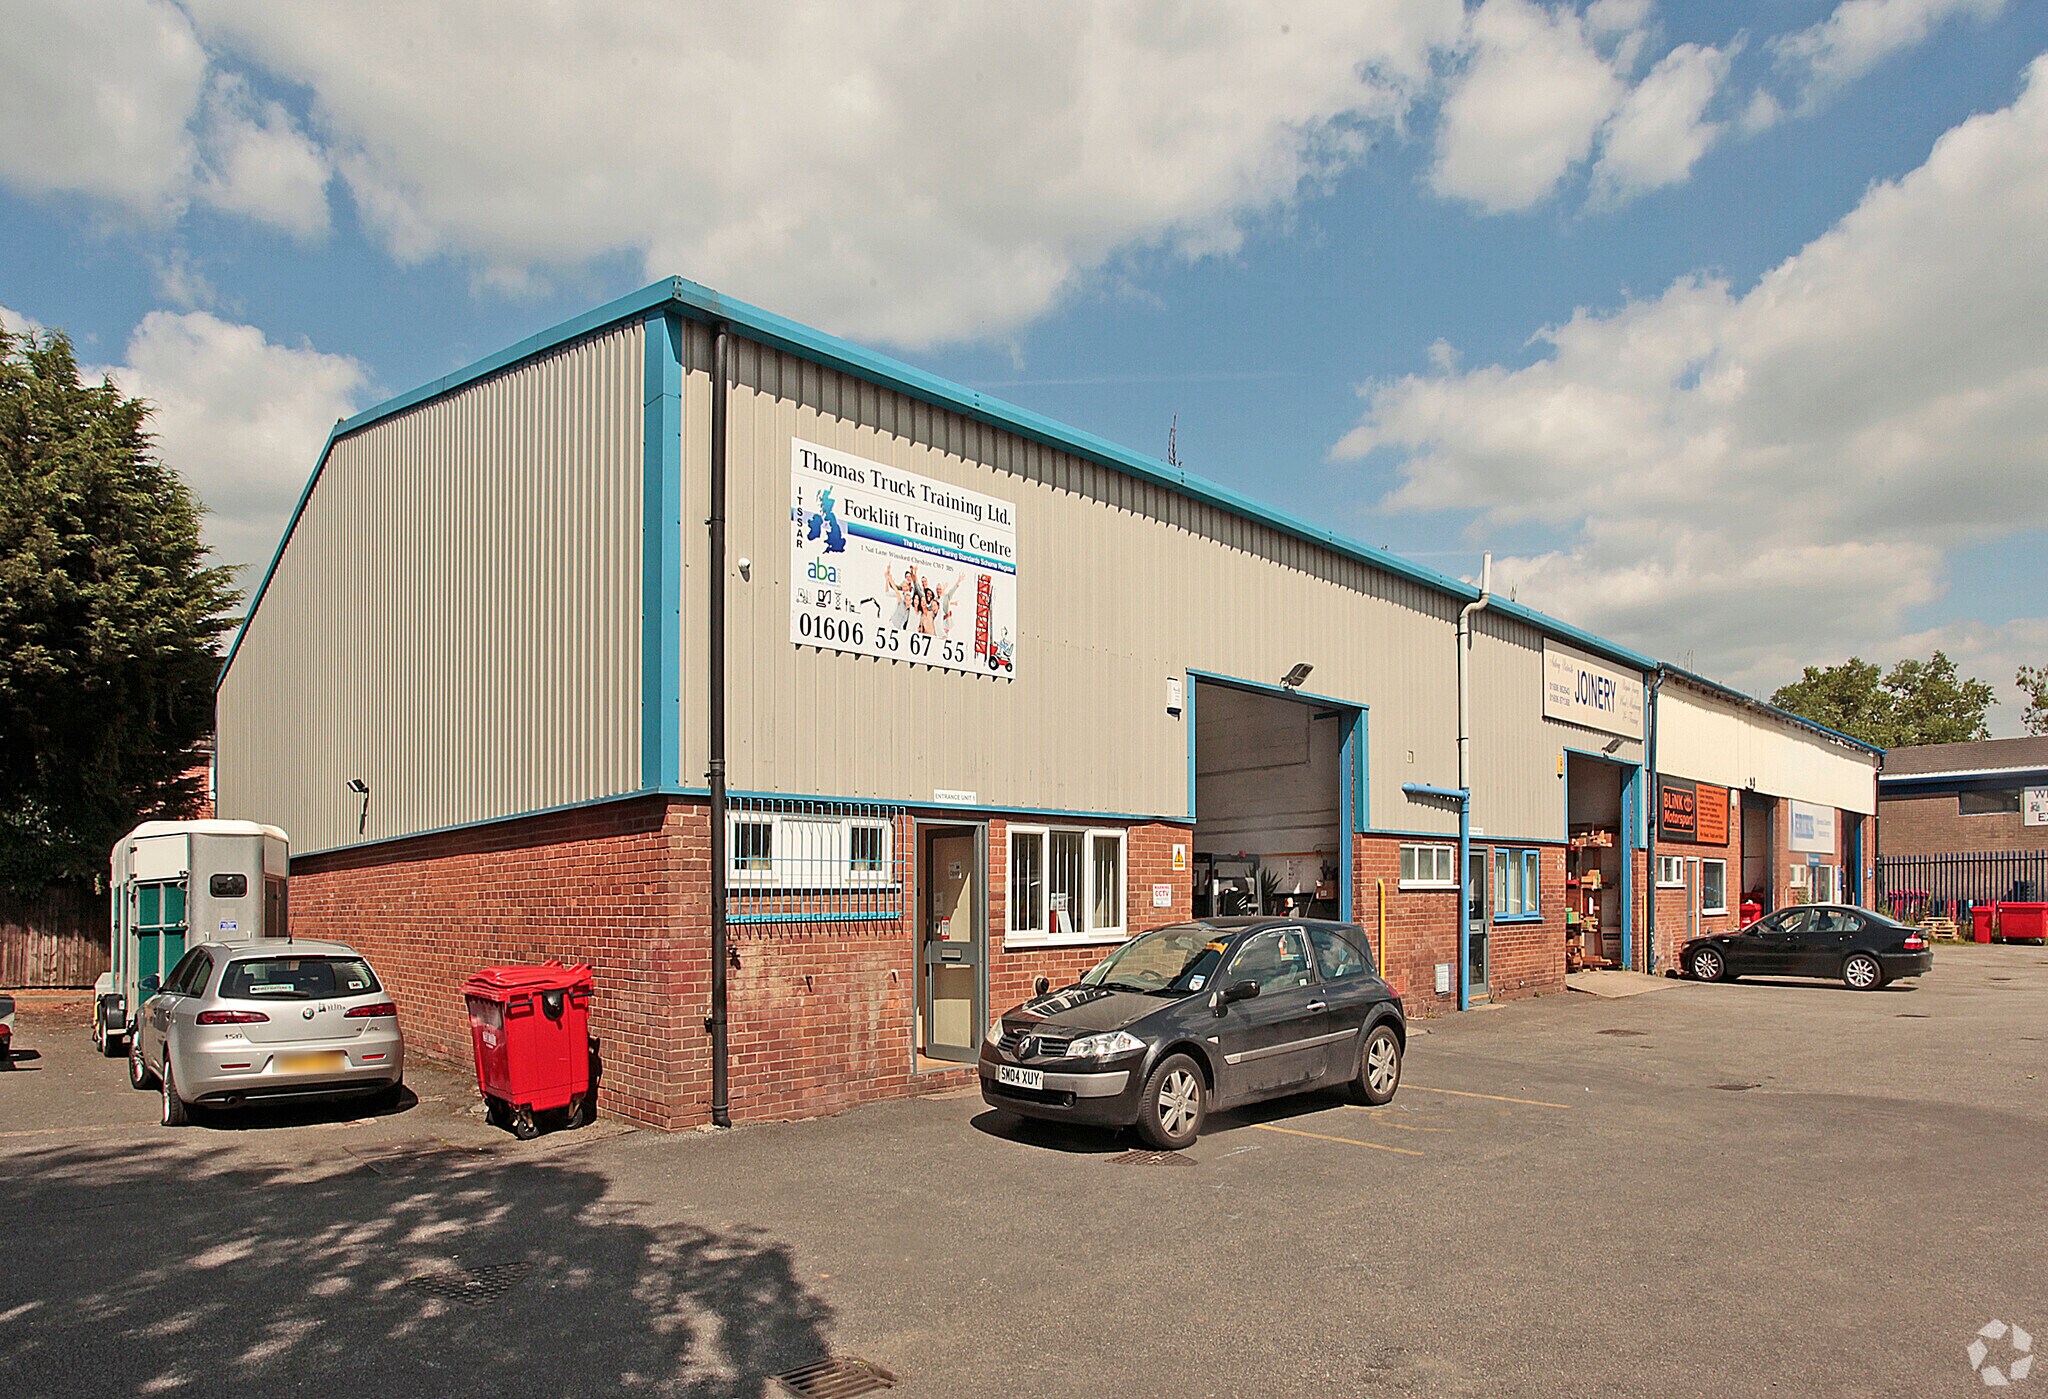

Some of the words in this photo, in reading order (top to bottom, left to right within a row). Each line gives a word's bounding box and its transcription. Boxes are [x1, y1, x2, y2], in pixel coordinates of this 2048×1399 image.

[800, 449, 865, 484] Thomas
[870, 469, 916, 498] Truck
[920, 484, 982, 521] Training
[987, 503, 1011, 526] Ltd.
[844, 498, 900, 529] Forklift
[904, 515, 964, 549] Training
[969, 533, 1012, 558] Centre
[903, 538, 912, 548] The
[807, 556, 837, 583] aba
[799, 613, 864, 646] 01606
[875, 627, 899, 651] 55
[910, 633, 932, 657] 67
[943, 640, 964, 663] 55
[1574, 669, 1617, 713] JOINERY
[935, 793, 960, 801] ENTRANCE
[1664, 809, 1694, 828] Motorsport
[1022, 1070, 1040, 1086] XUY
